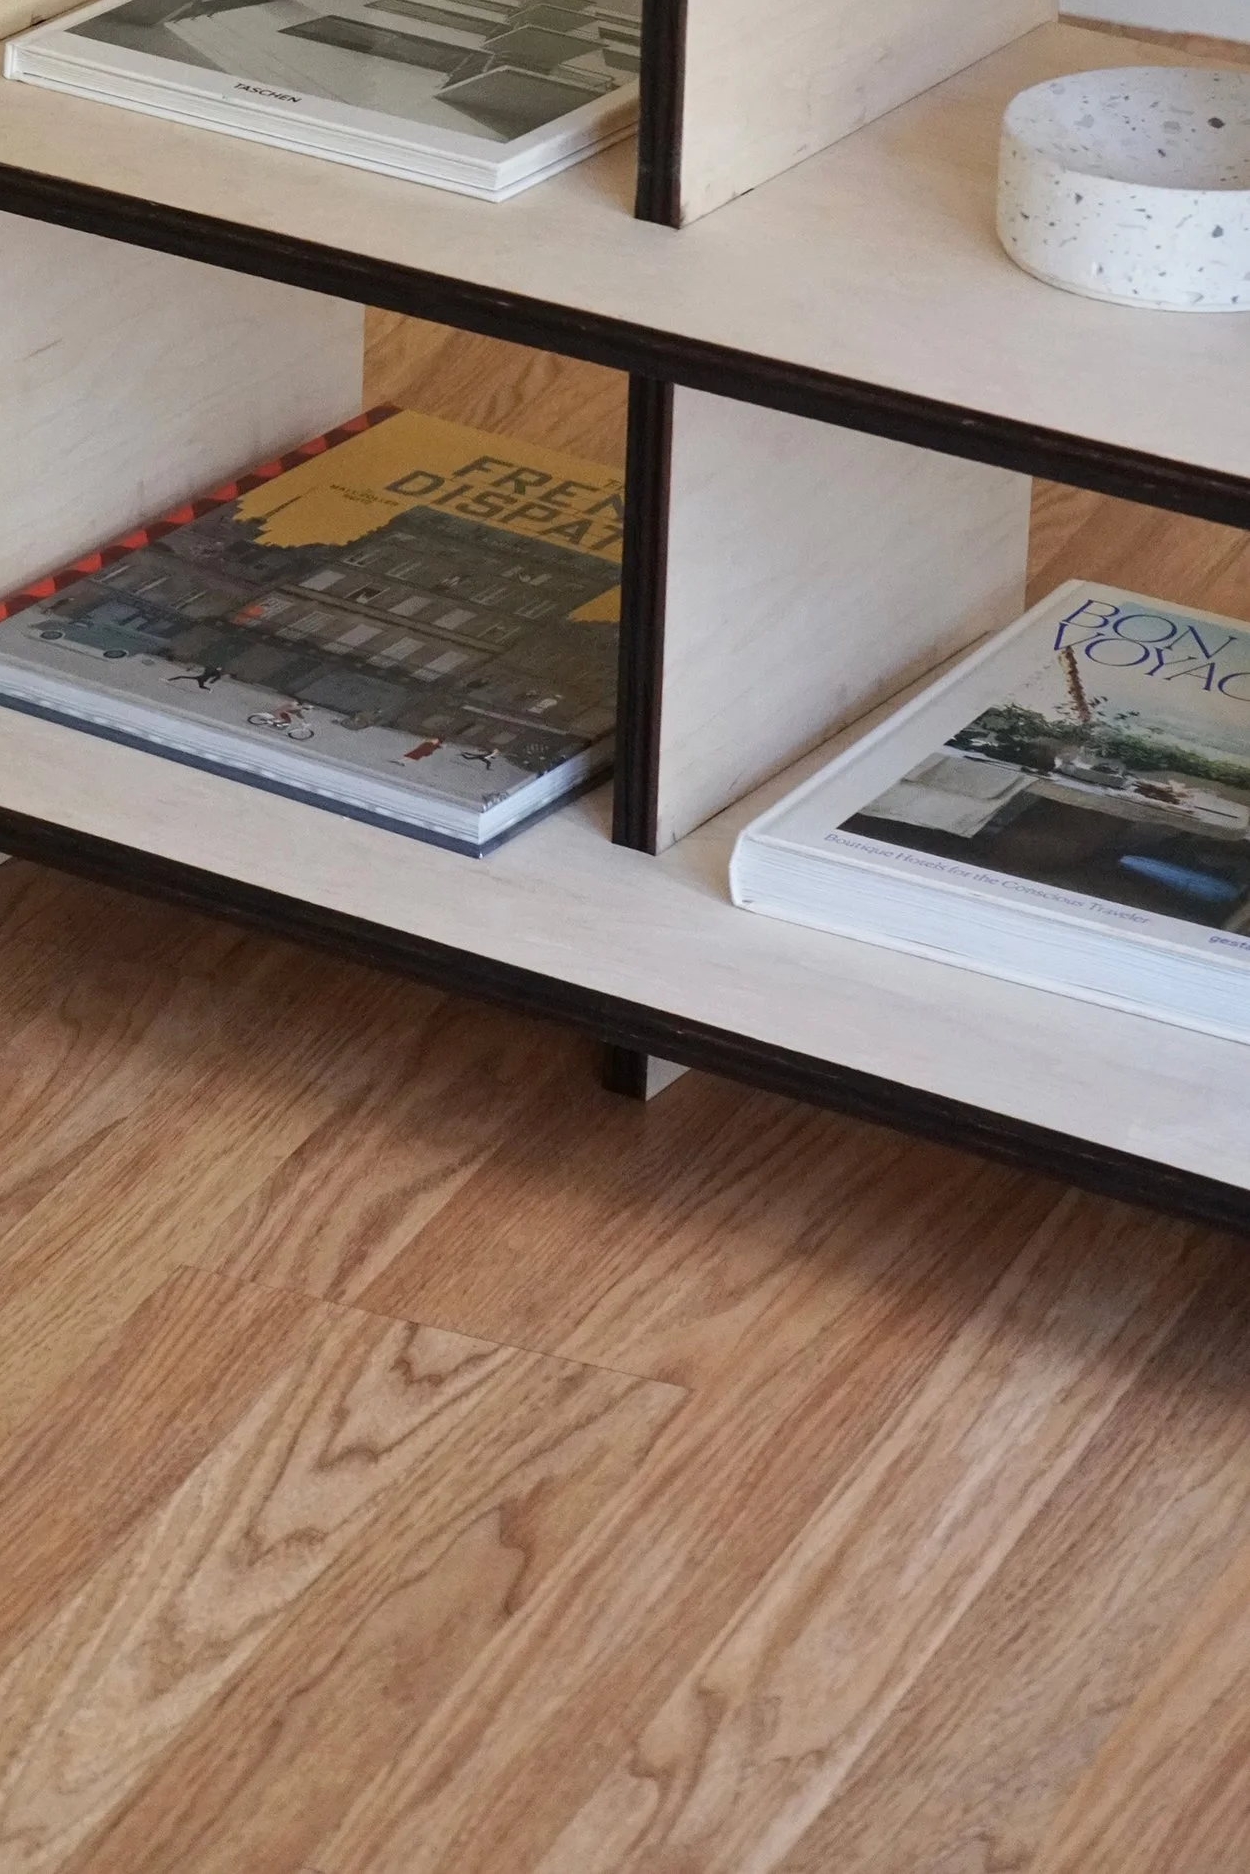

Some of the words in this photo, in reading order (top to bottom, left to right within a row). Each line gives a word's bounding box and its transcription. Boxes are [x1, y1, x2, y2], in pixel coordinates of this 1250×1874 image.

[233, 82, 303, 104] TASCHEN
[1061, 598, 1239, 660] BON
[823, 833, 895, 858] Boutique
[895, 852, 946, 872] Hotels
[947, 865, 973, 879] for
[973, 872, 1001, 886] the
[1001, 879, 1085, 908] Conscious
[1088, 901, 1150, 925] Traveler
